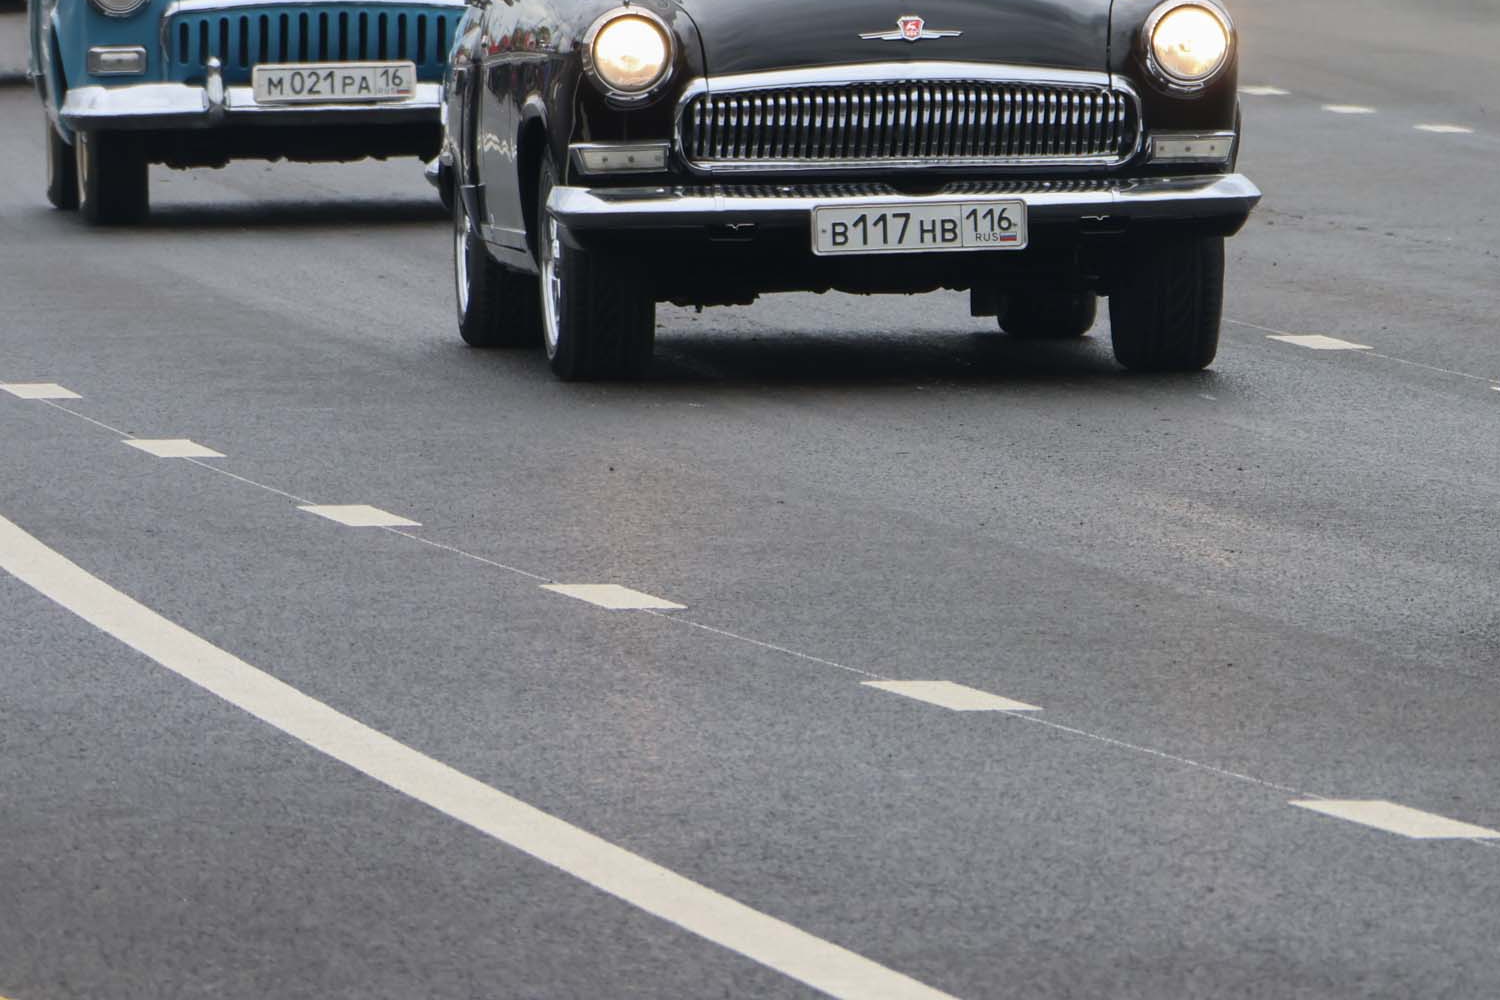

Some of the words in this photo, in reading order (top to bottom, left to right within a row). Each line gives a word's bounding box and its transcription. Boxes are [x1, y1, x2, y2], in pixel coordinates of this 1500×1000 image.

[380, 69, 404, 88] 16
[965, 207, 1013, 233] 116
[975, 232, 999, 242] RUS
